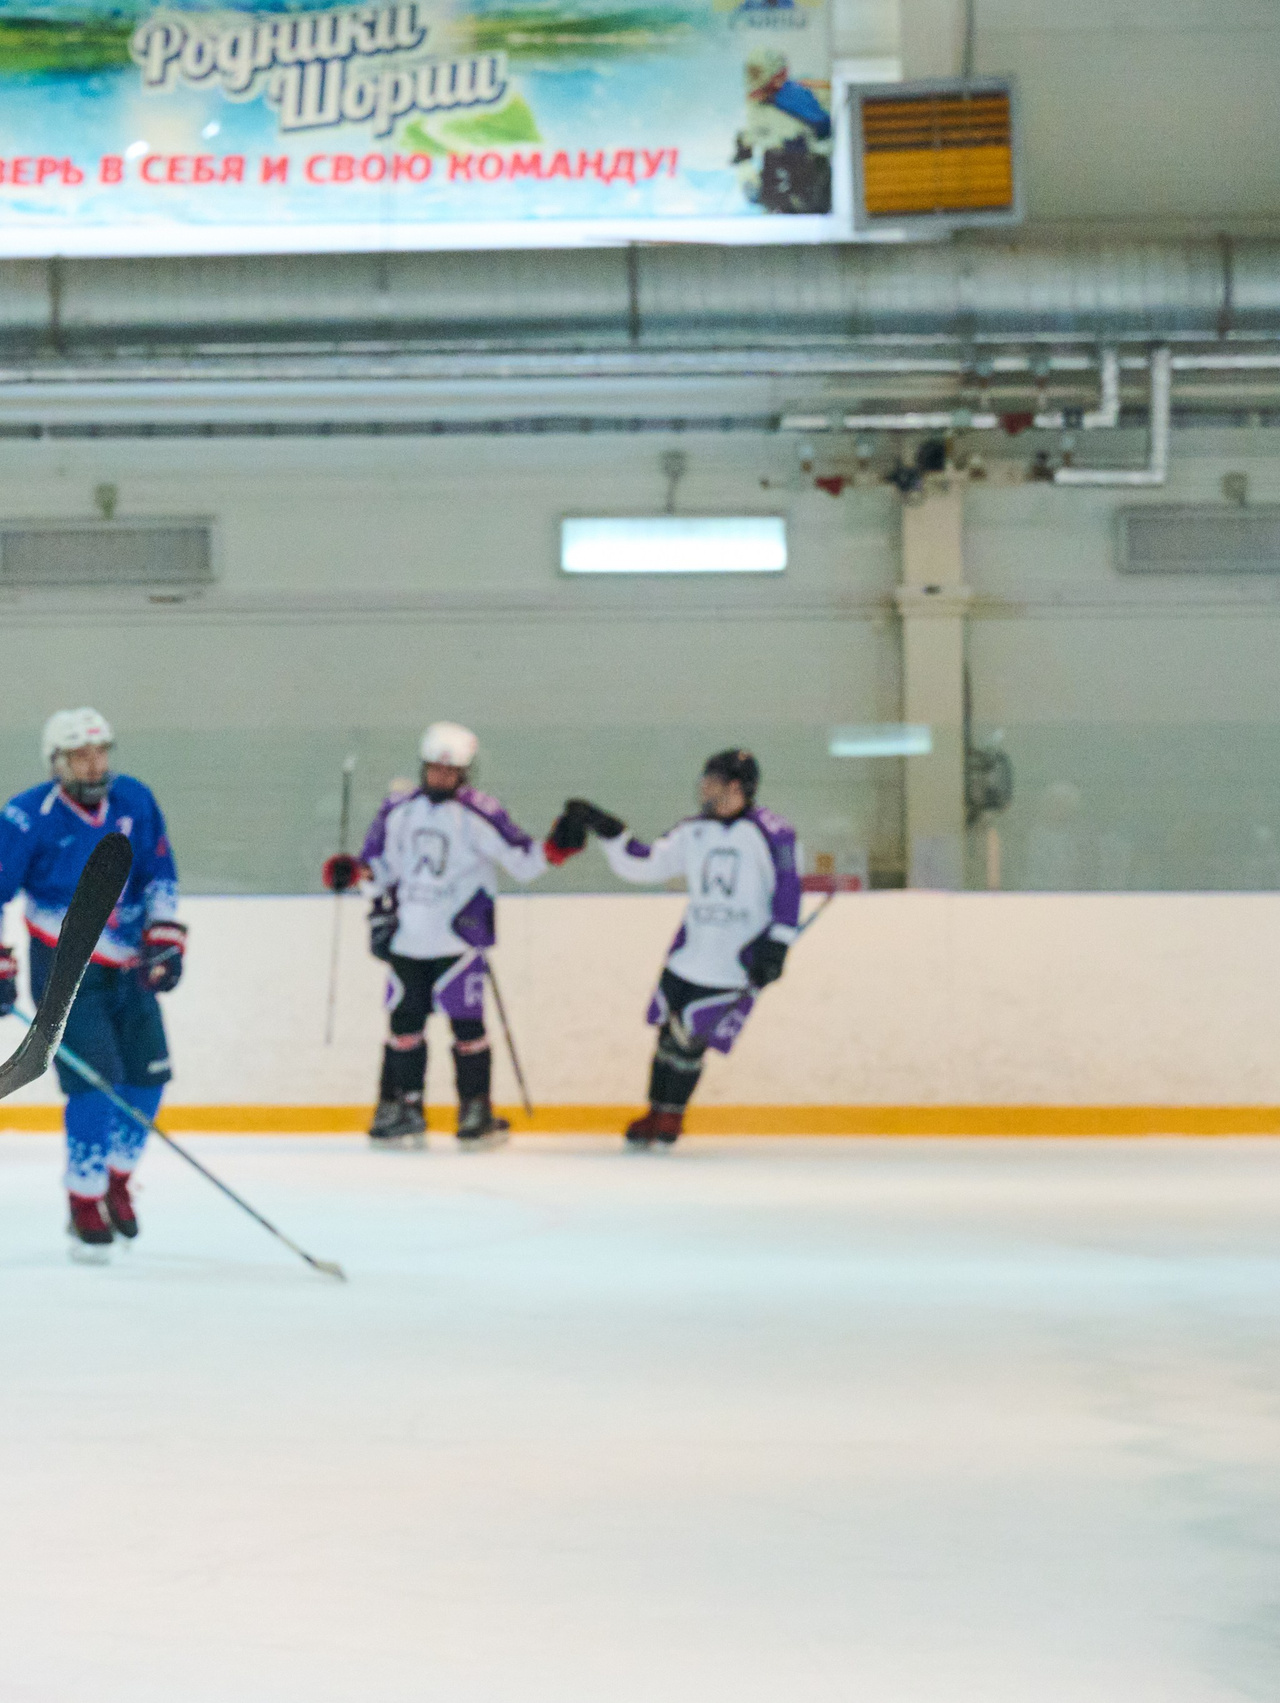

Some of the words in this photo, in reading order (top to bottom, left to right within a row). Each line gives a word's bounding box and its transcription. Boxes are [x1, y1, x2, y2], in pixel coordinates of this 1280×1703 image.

[132, 3, 426, 93] Родники
[271, 54, 508, 138] Шории
[99, 155, 124, 185] В
[139, 153, 245, 185] СЕБЯ
[261, 154, 290, 184] И
[304, 152, 433, 185] СВОЮ
[447, 148, 680, 187] КОМАНДУ!
